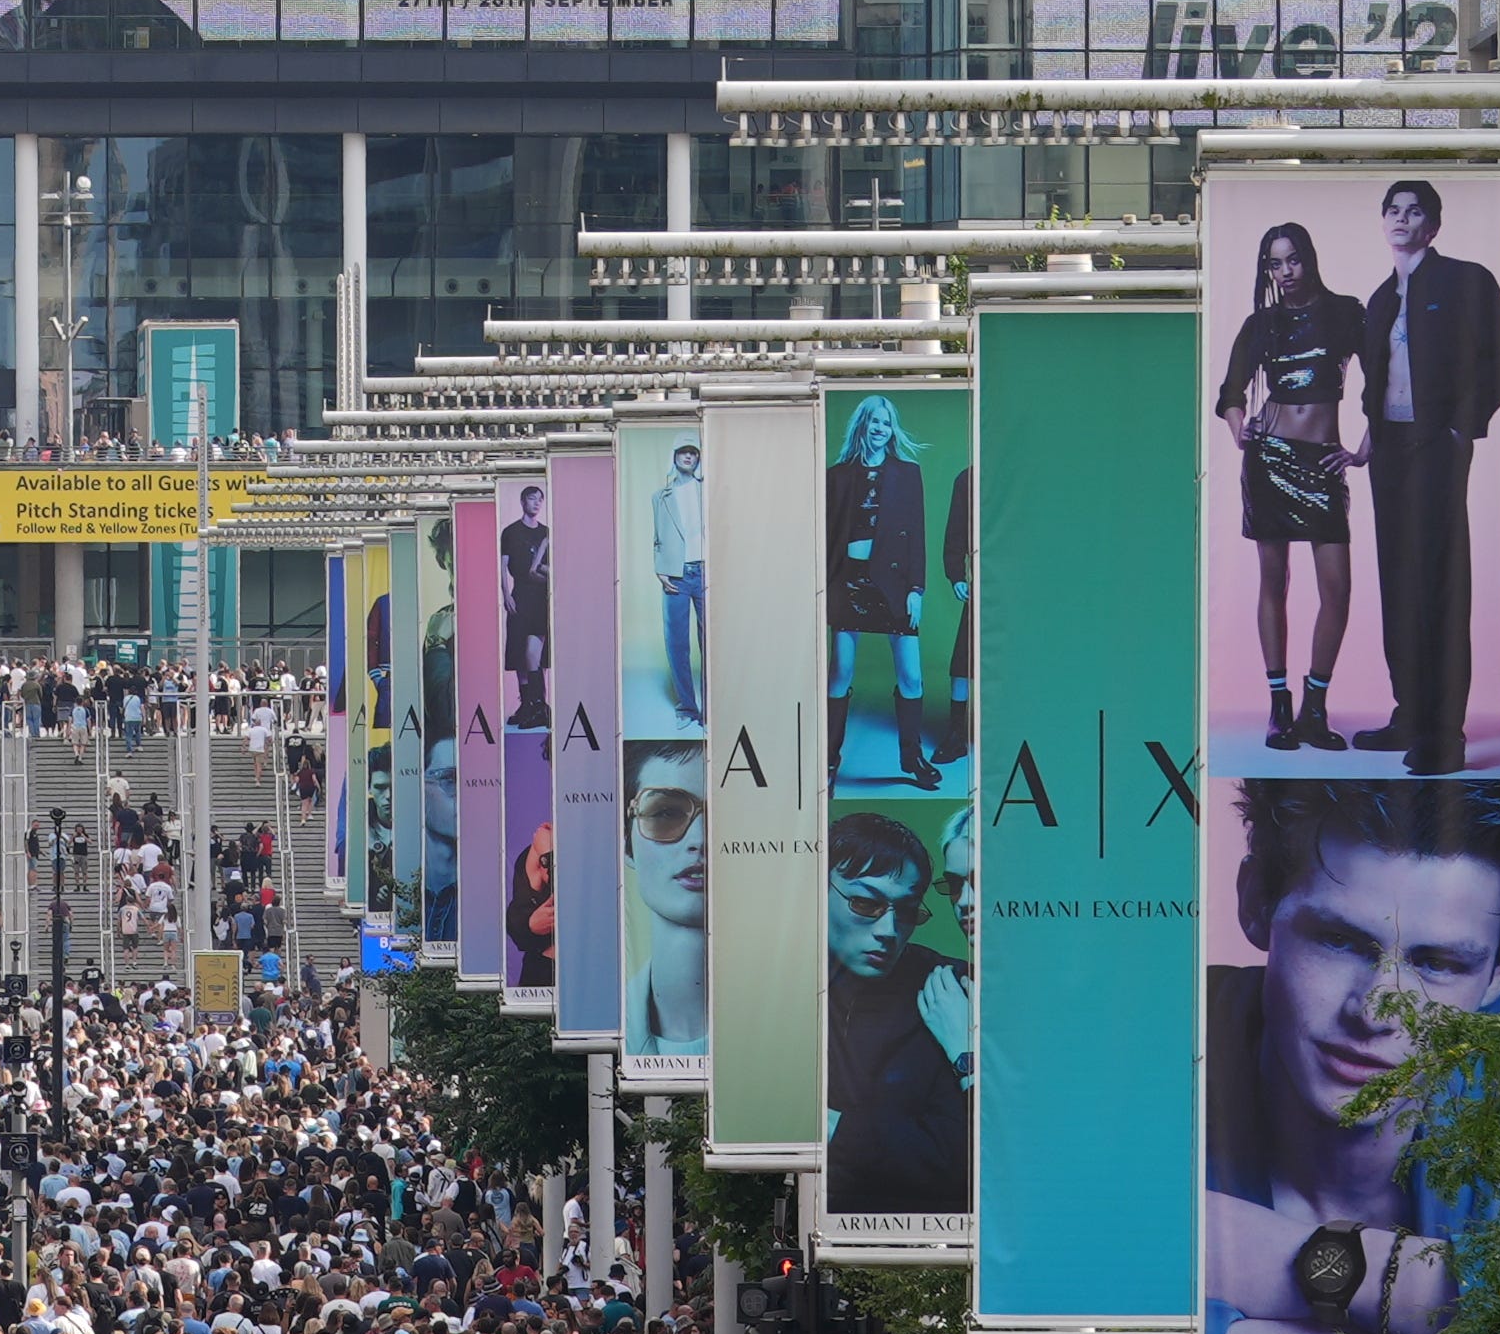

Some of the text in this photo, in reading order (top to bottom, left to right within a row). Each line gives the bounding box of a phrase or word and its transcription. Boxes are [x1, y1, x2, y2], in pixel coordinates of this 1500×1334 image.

[15, 474, 101, 492] Available
[106, 477, 126, 492] to
[131, 474, 152, 492] all
[16, 502, 214, 522] Pitch Standing tickes
[16, 522, 57, 535] Follow
[60, 522, 82, 535] Red
[85, 522, 96, 535] &
[99, 522, 138, 535] Yellow
[141, 523, 175, 535] Zones
[563, 793, 614, 804] ARMANI
[720, 841, 784, 855] ARMANI
[992, 900, 1080, 918] ARMANI
[633, 1058, 690, 1069] ARMANI
[249, 1202, 267, 1214] 25
[836, 1217, 911, 1232] ARMANI
